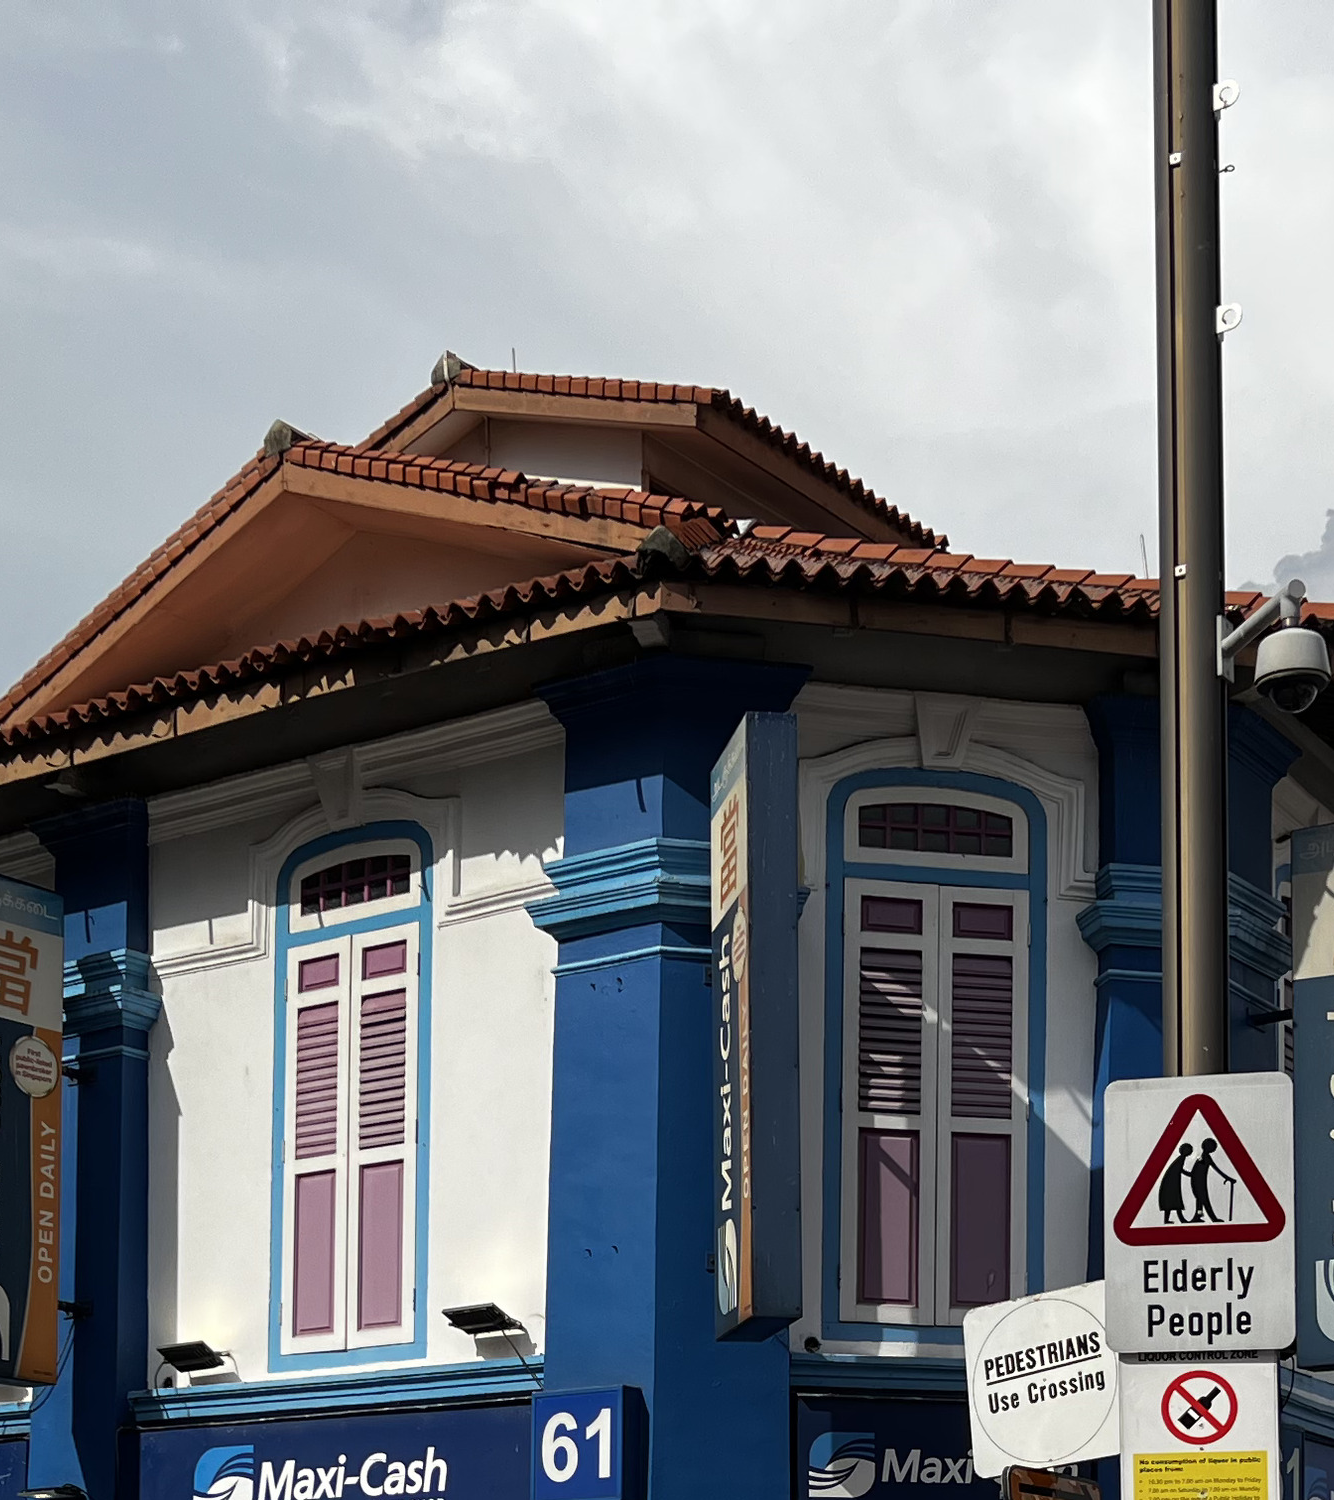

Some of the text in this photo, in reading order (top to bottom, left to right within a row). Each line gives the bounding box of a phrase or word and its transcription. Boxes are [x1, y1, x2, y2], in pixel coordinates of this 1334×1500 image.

[720, 793, 739, 911] 當
[718, 934, 732, 1211] Maxi-Cash
[741, 1004, 751, 1199] OPEN DAILY
[37, 1121, 57, 1284] OPEN DAILY
[1143, 1258, 1254, 1299] Elderly
[1147, 1302, 1252, 1344] People
[984, 1331, 1101, 1380] PEDESTRIANS
[1179, 1351, 1228, 1360] CONTROL
[1230, 1350, 1259, 1359] ZONE
[988, 1371, 1106, 1414] Use Crossing
[540, 1406, 614, 1484] 61
